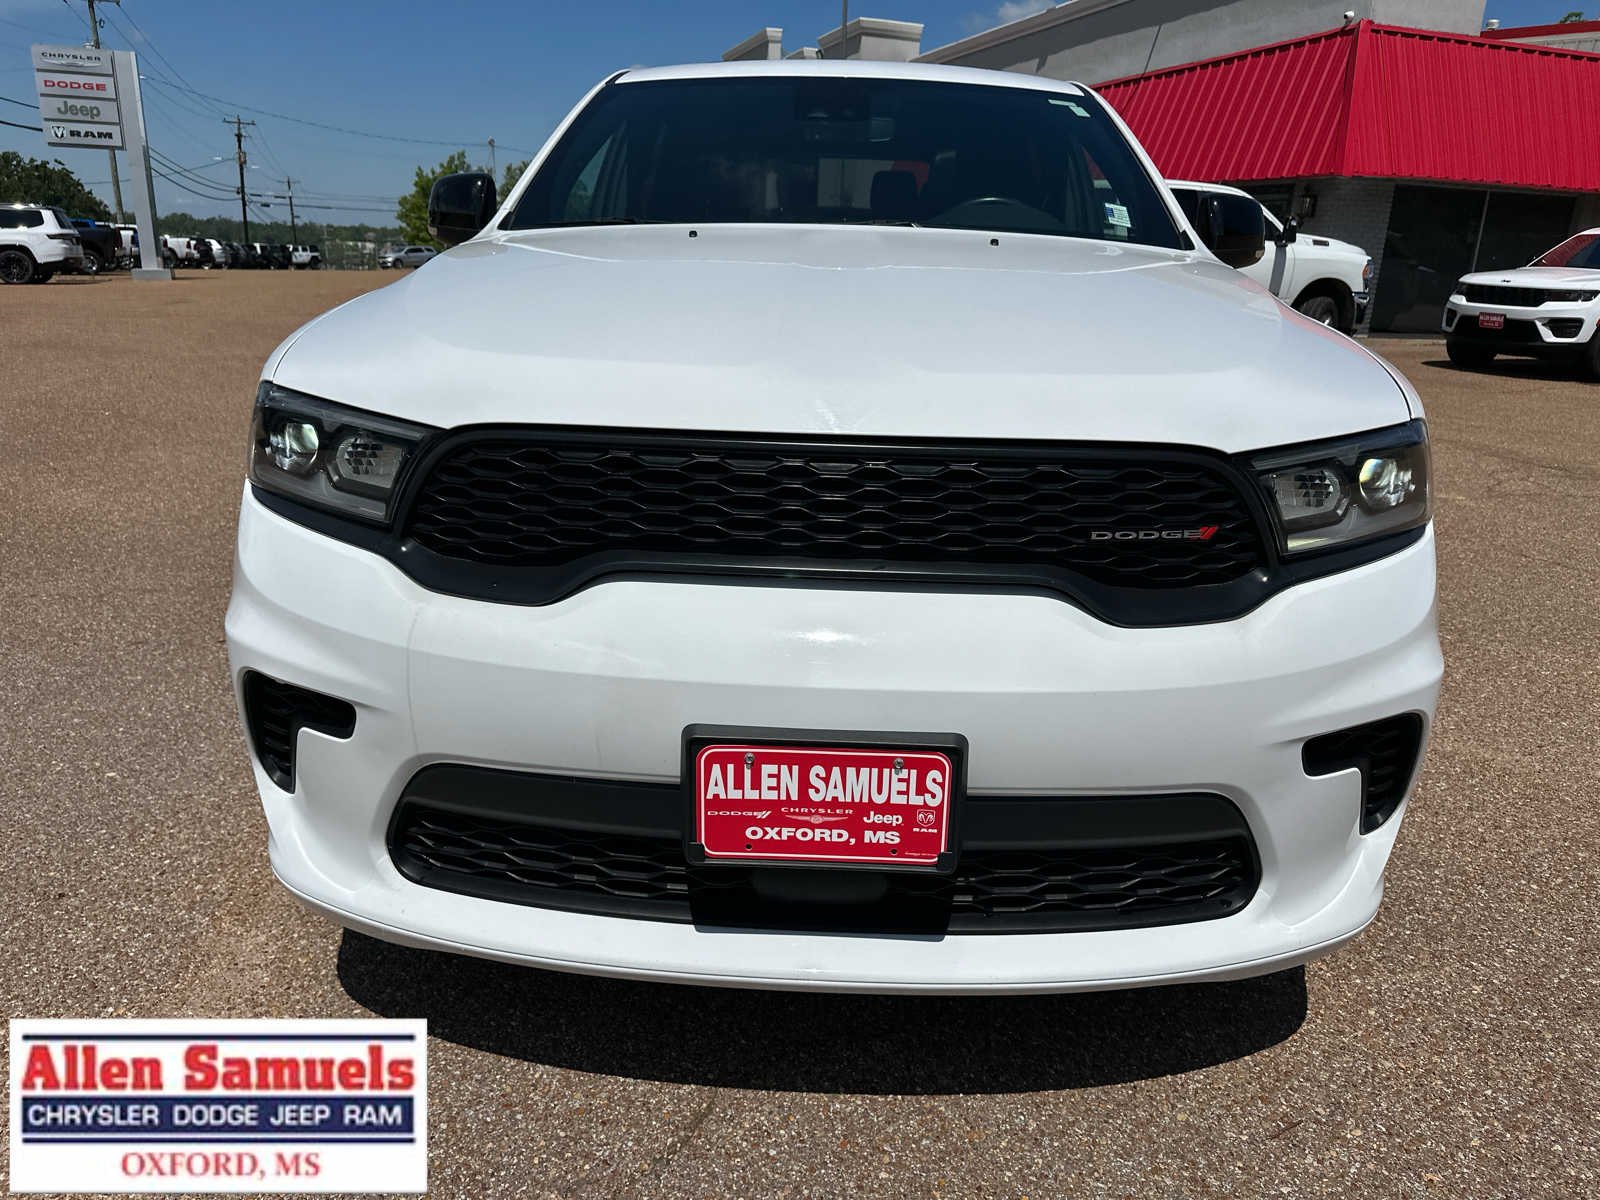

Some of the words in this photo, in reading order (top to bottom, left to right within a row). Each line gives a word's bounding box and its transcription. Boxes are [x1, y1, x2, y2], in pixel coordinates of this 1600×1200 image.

[41, 51, 101, 61] CHRYSLER
[44, 80, 107, 91] DODGE
[57, 100, 101, 119] Jeep
[69, 129, 113, 140] RAM
[1091, 530, 1202, 540] DODGE
[706, 763, 799, 800] ALLEN
[808, 765, 943, 807] SAMUELS
[863, 811, 903, 826] Jeep
[745, 826, 856, 845] OXFORD,
[863, 830, 901, 844] MS
